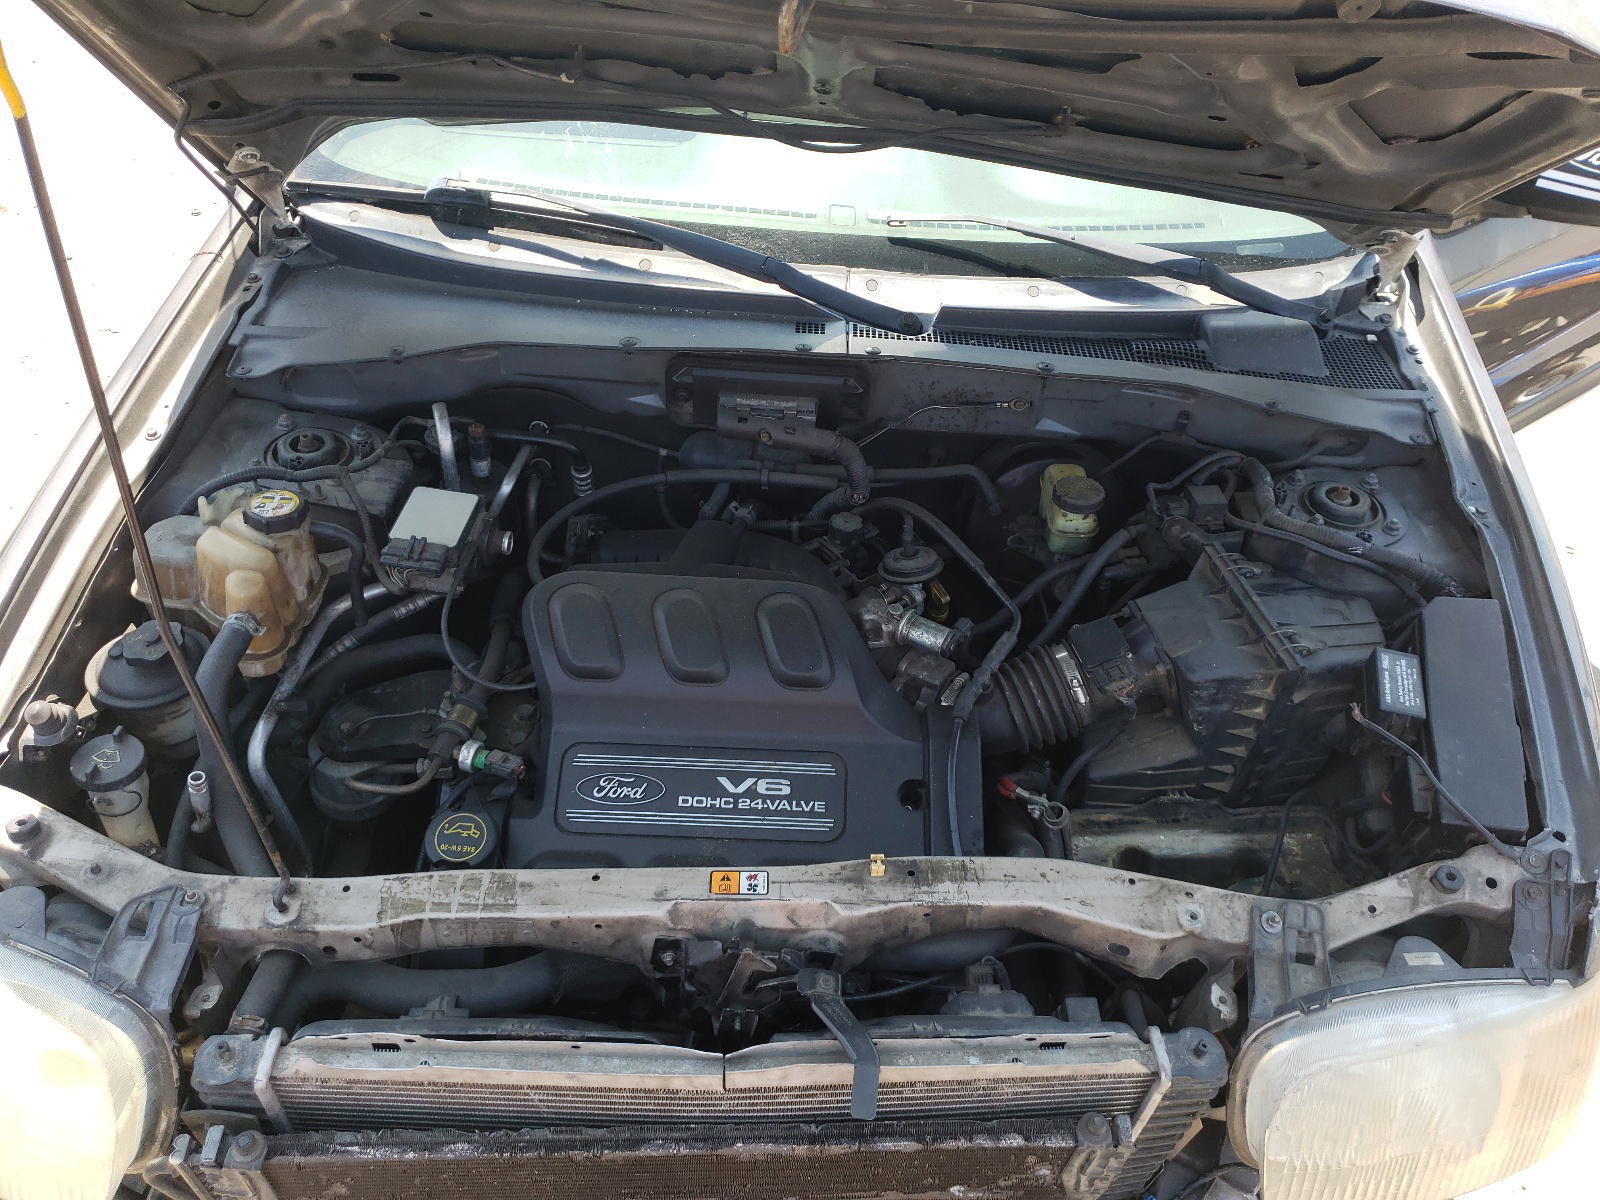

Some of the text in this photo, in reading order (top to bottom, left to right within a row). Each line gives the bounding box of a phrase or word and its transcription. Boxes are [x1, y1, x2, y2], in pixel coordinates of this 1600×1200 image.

[593, 775, 648, 800] Ford
[716, 776, 791, 795] V6
[678, 795, 826, 812] DOHC 24-VALVE
